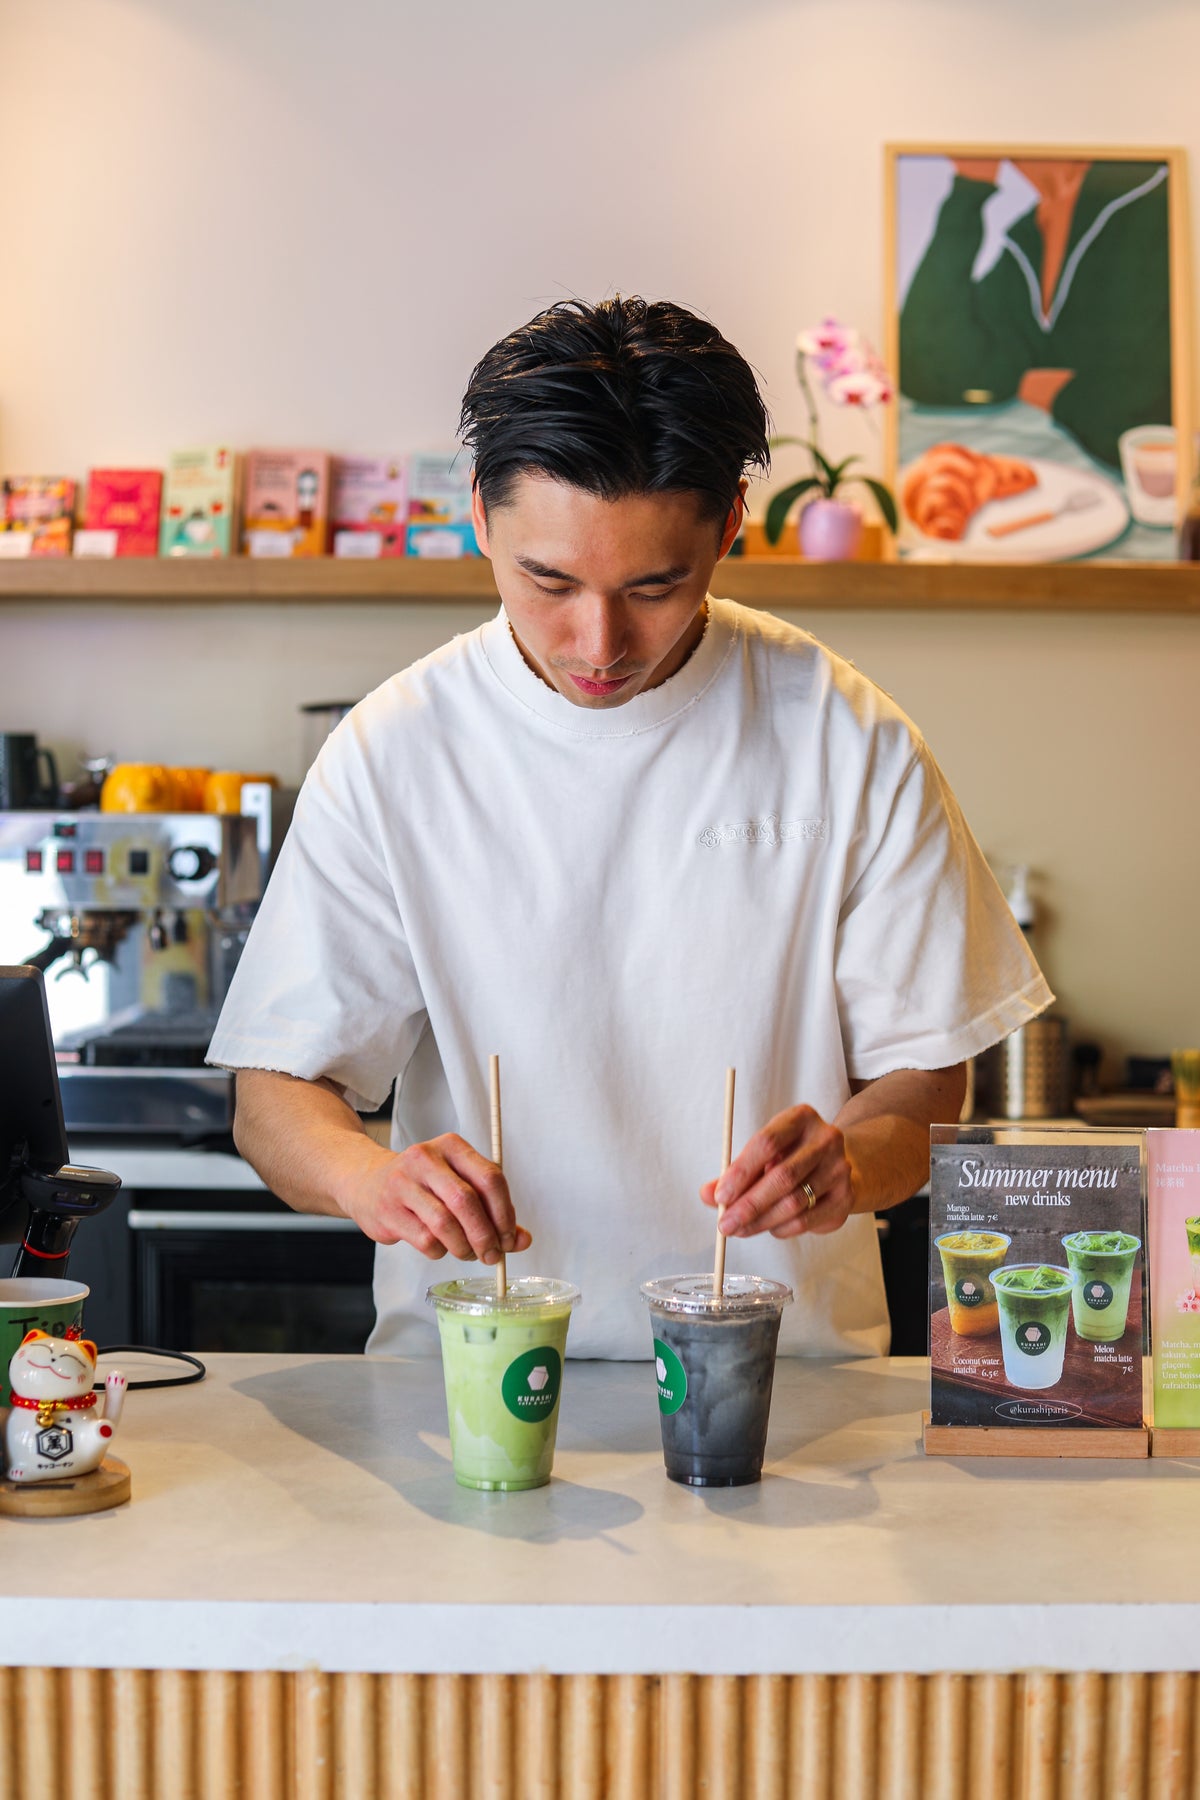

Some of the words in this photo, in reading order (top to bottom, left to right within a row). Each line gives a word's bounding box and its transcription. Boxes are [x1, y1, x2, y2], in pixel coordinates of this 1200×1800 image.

[1155, 1162, 1194, 1173] Matcha
[958, 1160, 1053, 1188] Summer
[1055, 1168, 1118, 1189] menu
[1005, 1193, 1029, 1206] new
[1032, 1190, 1071, 1206] drinks
[946, 1203, 970, 1214] Mango
[946, 1212, 970, 1221] matcha
[970, 1212, 985, 1221] latte
[987, 1213, 999, 1223] 7€
[1094, 1344, 1115, 1353] Melon
[953, 1356, 981, 1366] Coconut
[1094, 1354, 1117, 1363] matcha
[1118, 1354, 1133, 1362] latte
[953, 1366, 977, 1374] matcha
[981, 1368, 999, 1379] 6.5€
[1122, 1365, 1134, 1375] 7€
[1009, 1403, 1069, 1417] @kurashiparis
